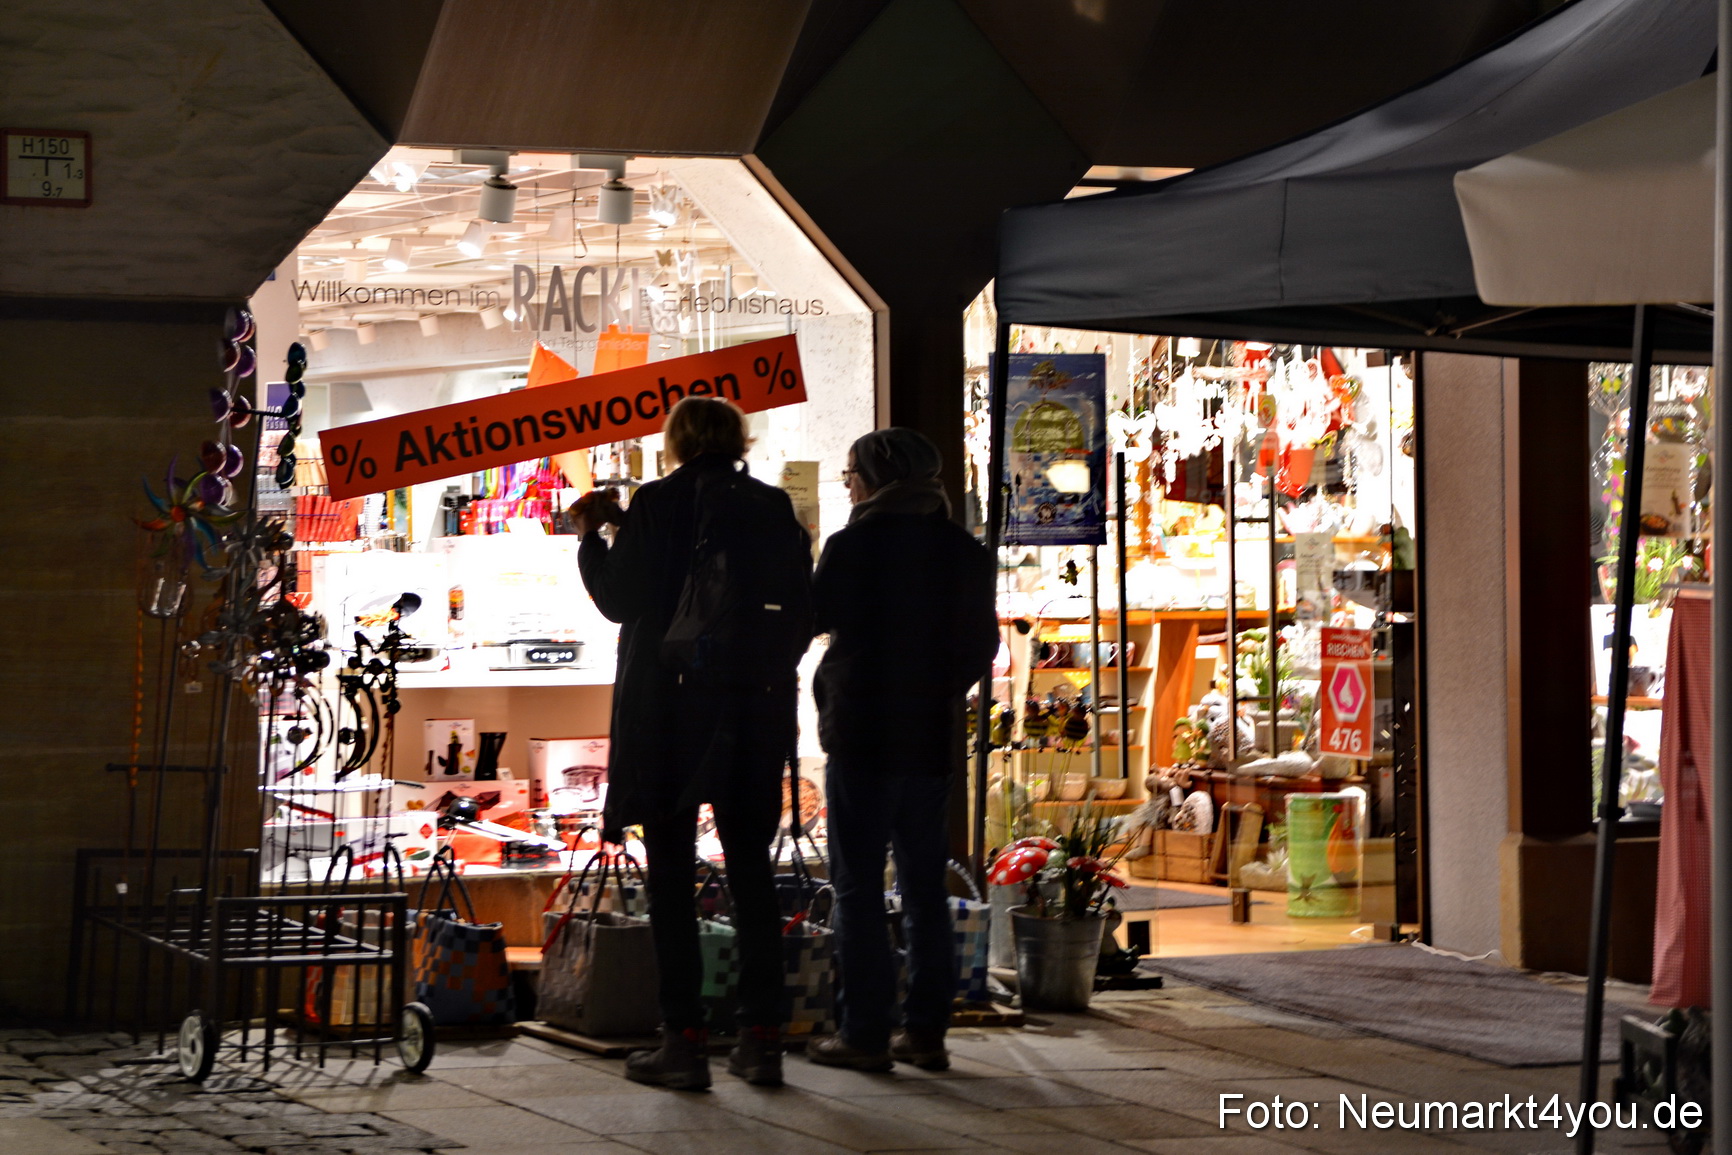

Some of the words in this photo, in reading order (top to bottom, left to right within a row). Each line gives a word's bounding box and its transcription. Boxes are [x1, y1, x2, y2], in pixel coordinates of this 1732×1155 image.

[291, 279, 461, 306] Willkommen
[470, 285, 501, 307] im
[330, 438, 378, 485] %
[394, 372, 741, 473] Aktionswochen
[753, 351, 797, 396] %
[1329, 727, 1362, 752] 476
